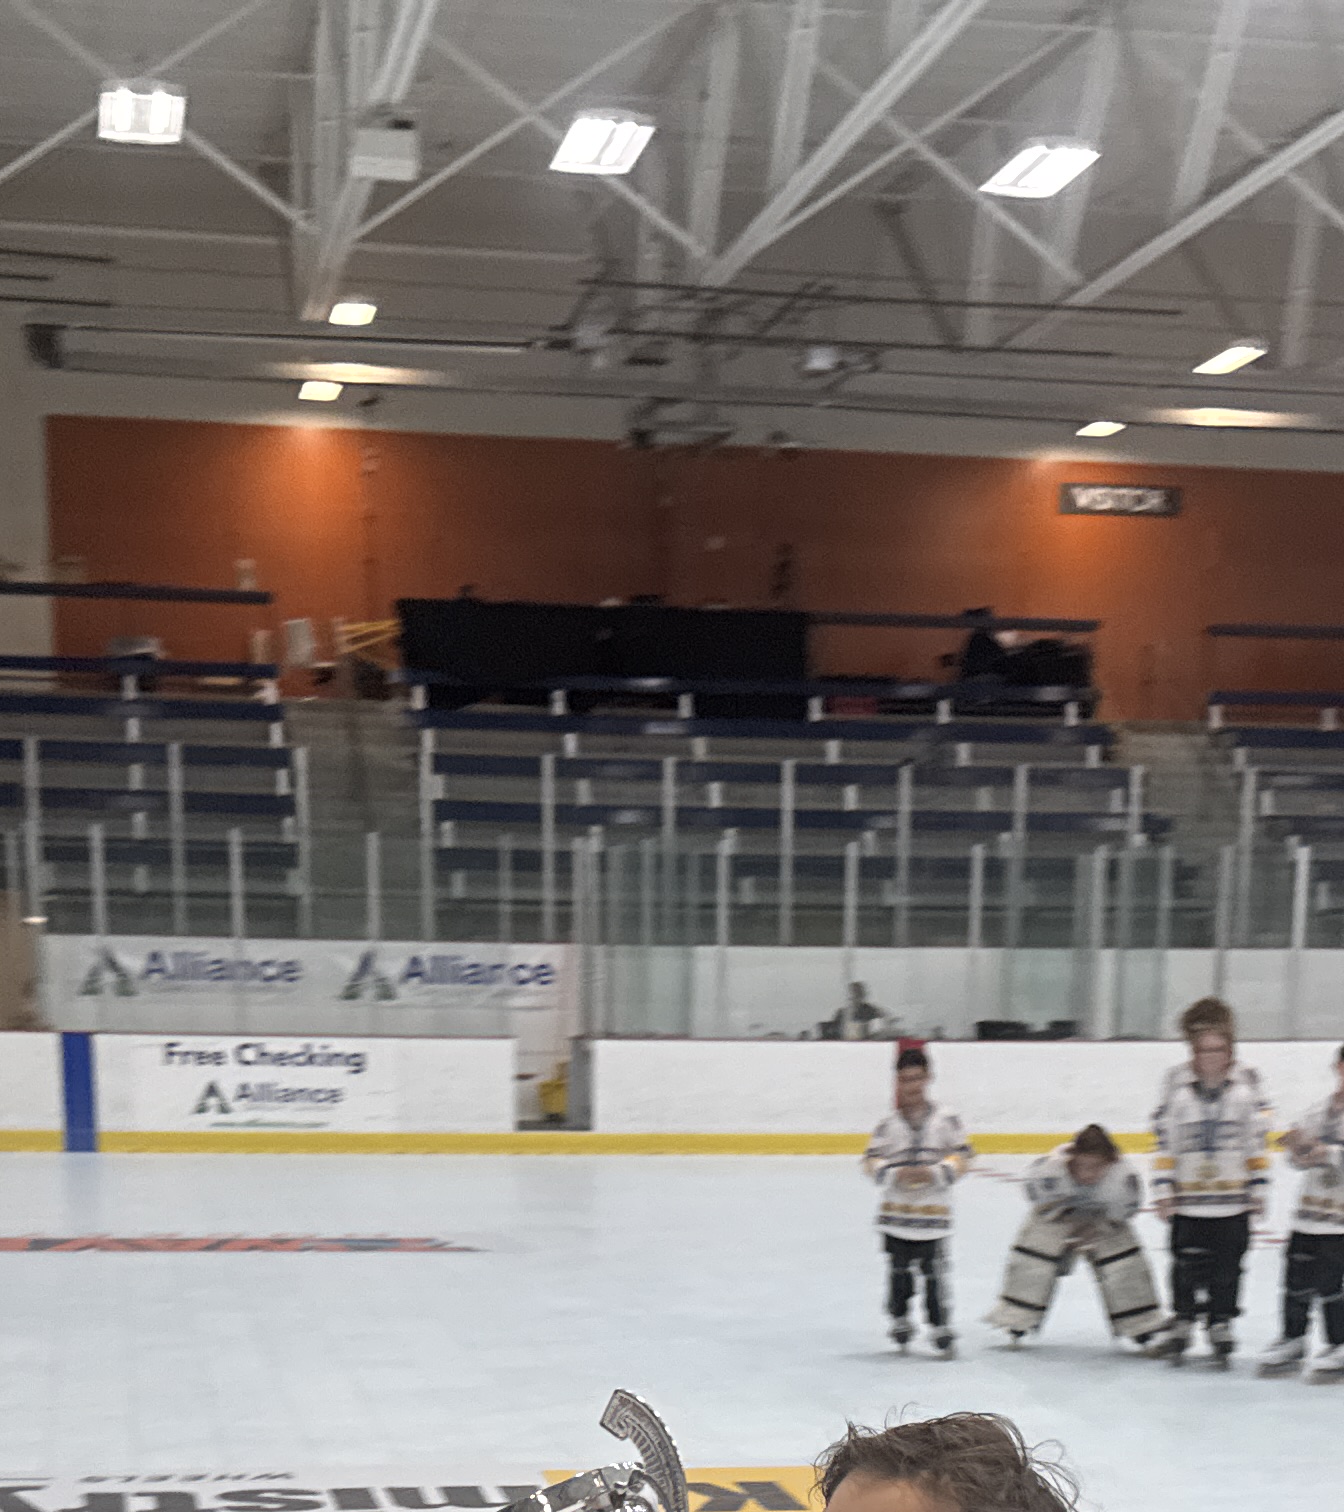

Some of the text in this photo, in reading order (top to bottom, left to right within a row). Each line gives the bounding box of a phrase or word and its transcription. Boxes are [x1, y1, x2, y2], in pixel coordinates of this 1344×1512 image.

[141, 950, 304, 983] Alliance
[401, 954, 555, 986] Alliance
[164, 1041, 368, 1074] Free Checking
[234, 1082, 346, 1103] Alliance
